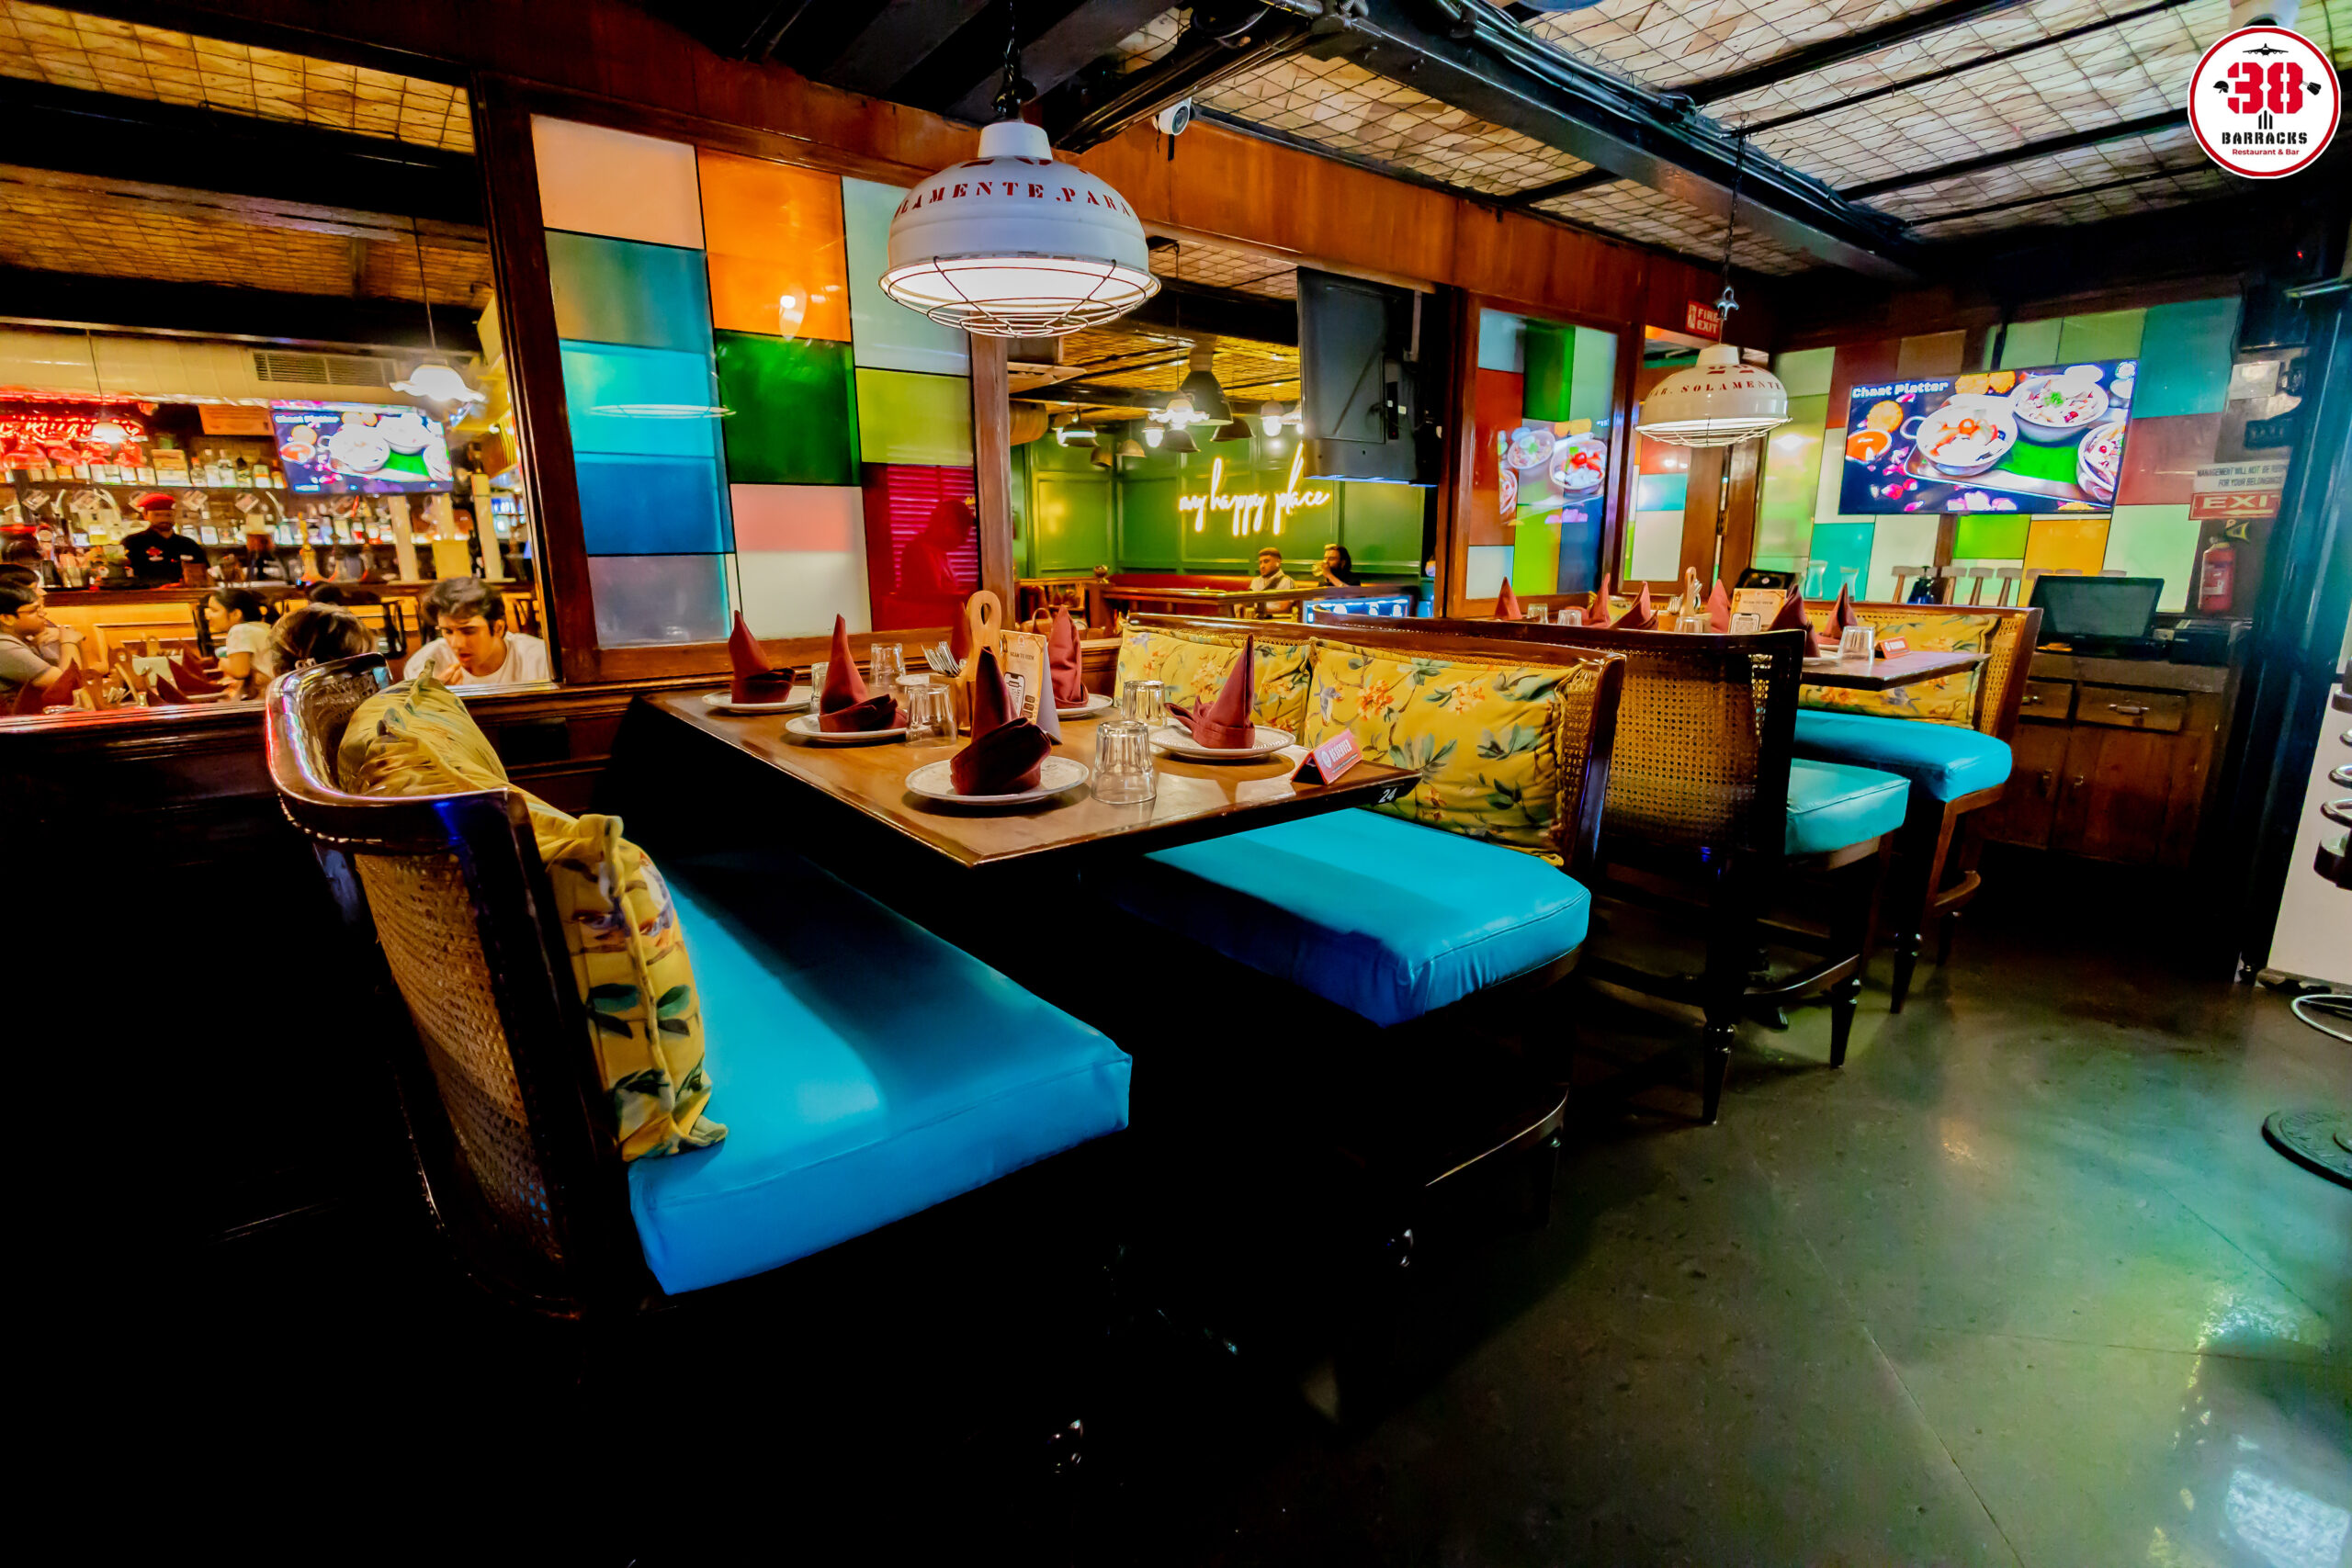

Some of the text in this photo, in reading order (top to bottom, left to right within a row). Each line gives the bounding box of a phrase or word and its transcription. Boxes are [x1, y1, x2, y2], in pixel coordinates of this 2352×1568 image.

[1698, 308, 1721, 322] FIRE
[1697, 319, 1718, 333] EXIT
[1851, 381, 1949, 399] Chaat Platter
[1179, 441, 1330, 536] my happy place
